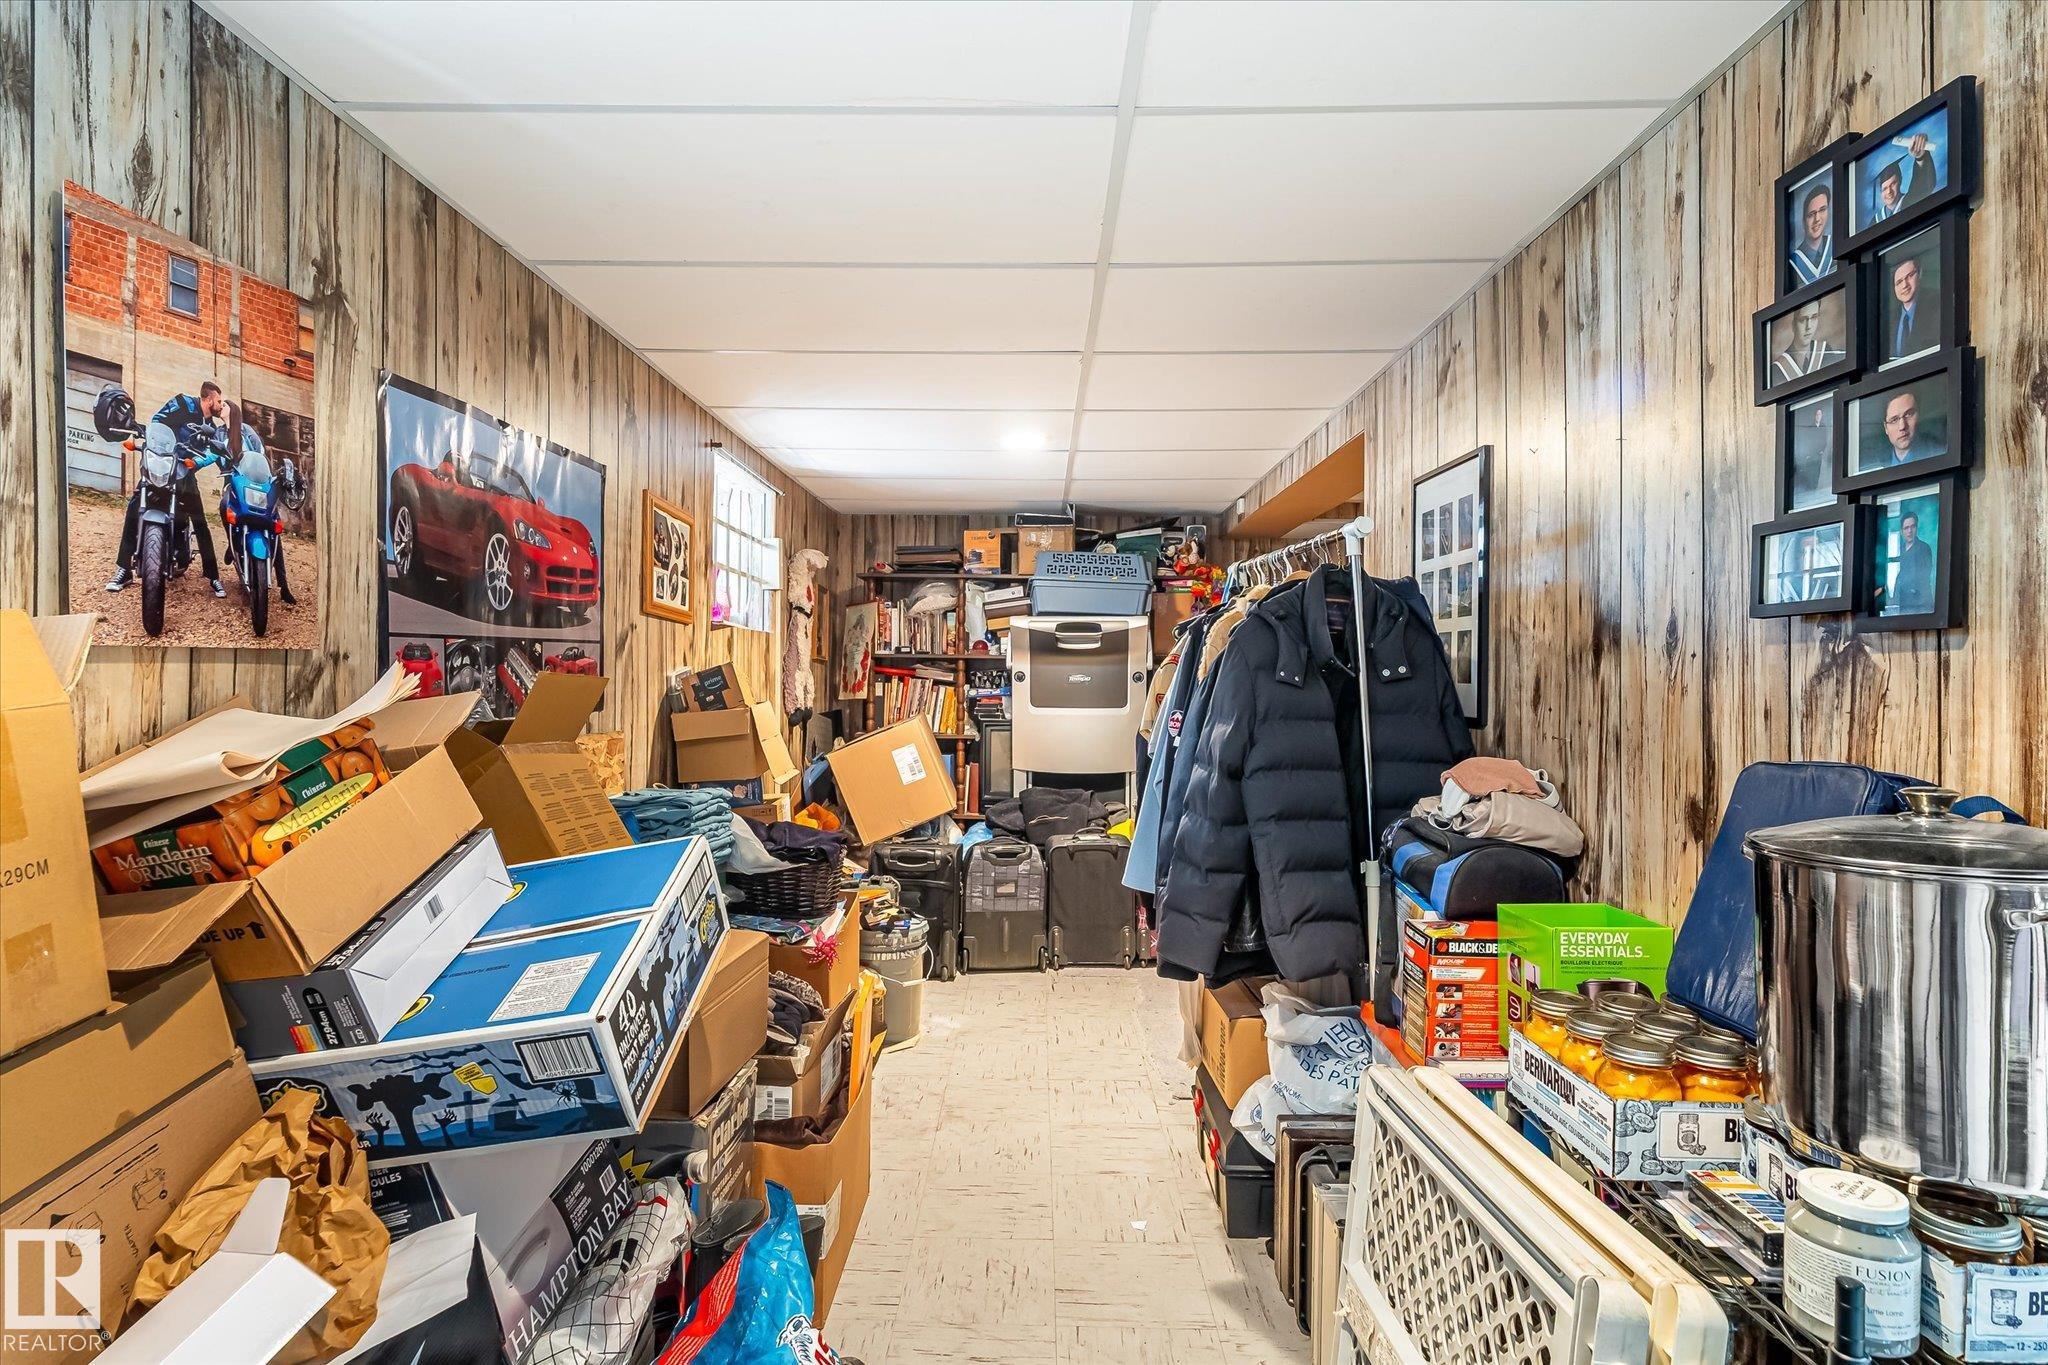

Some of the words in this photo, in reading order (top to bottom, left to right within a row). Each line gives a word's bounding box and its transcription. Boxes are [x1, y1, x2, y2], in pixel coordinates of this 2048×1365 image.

[301, 781, 328, 799] Chinese
[279, 781, 361, 835] Mandarin
[143, 838, 170, 849] Chinese
[112, 843, 213, 871] Mandarin
[128, 856, 213, 884] ORANGES
[222, 927, 246, 941] UP
[1560, 931, 1630, 945] EVERYDAY
[1448, 942, 1499, 954] BLACK&DE
[619, 989, 637, 1033] 40
[318, 1010, 339, 1046] 27,94cm
[619, 1000, 648, 1060] HALLOWEEN
[1299, 1057, 1326, 1081] DES
[1523, 1049, 1577, 1108] BERNARDIN
[370, 1172, 402, 1188] OULES
[508, 1216, 604, 1361] HAMPTON
[601, 1177, 633, 1231] BAY
[1855, 1265, 1912, 1283] FUSION
[2017, 1342, 2026, 1351] 12
